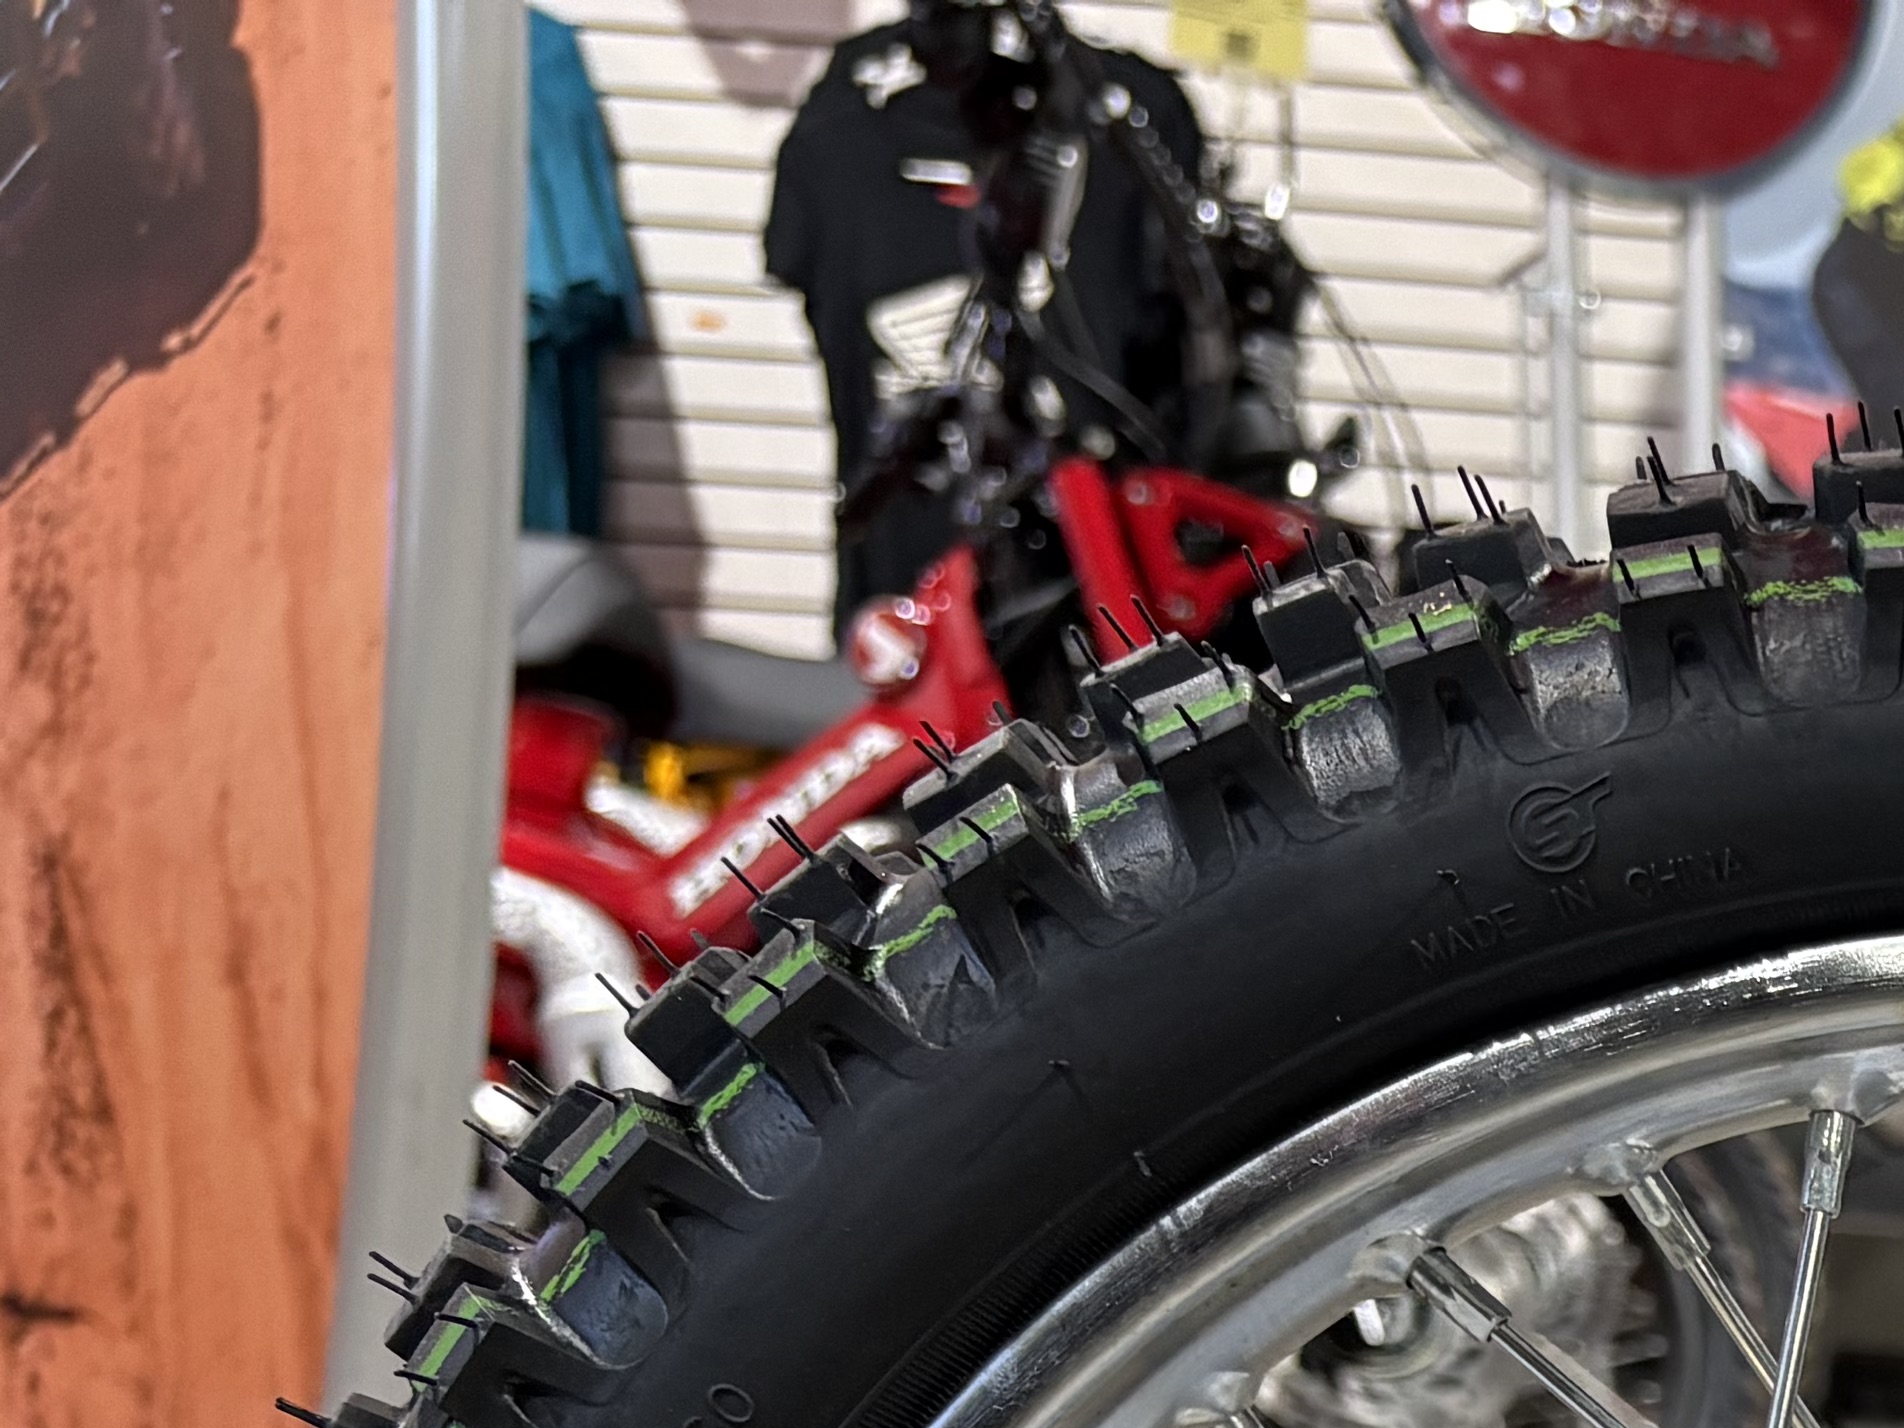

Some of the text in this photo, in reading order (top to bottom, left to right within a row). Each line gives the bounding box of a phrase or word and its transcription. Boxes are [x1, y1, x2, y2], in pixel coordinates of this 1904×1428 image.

[1410, 845, 1746, 974] MADE IN CHINA
